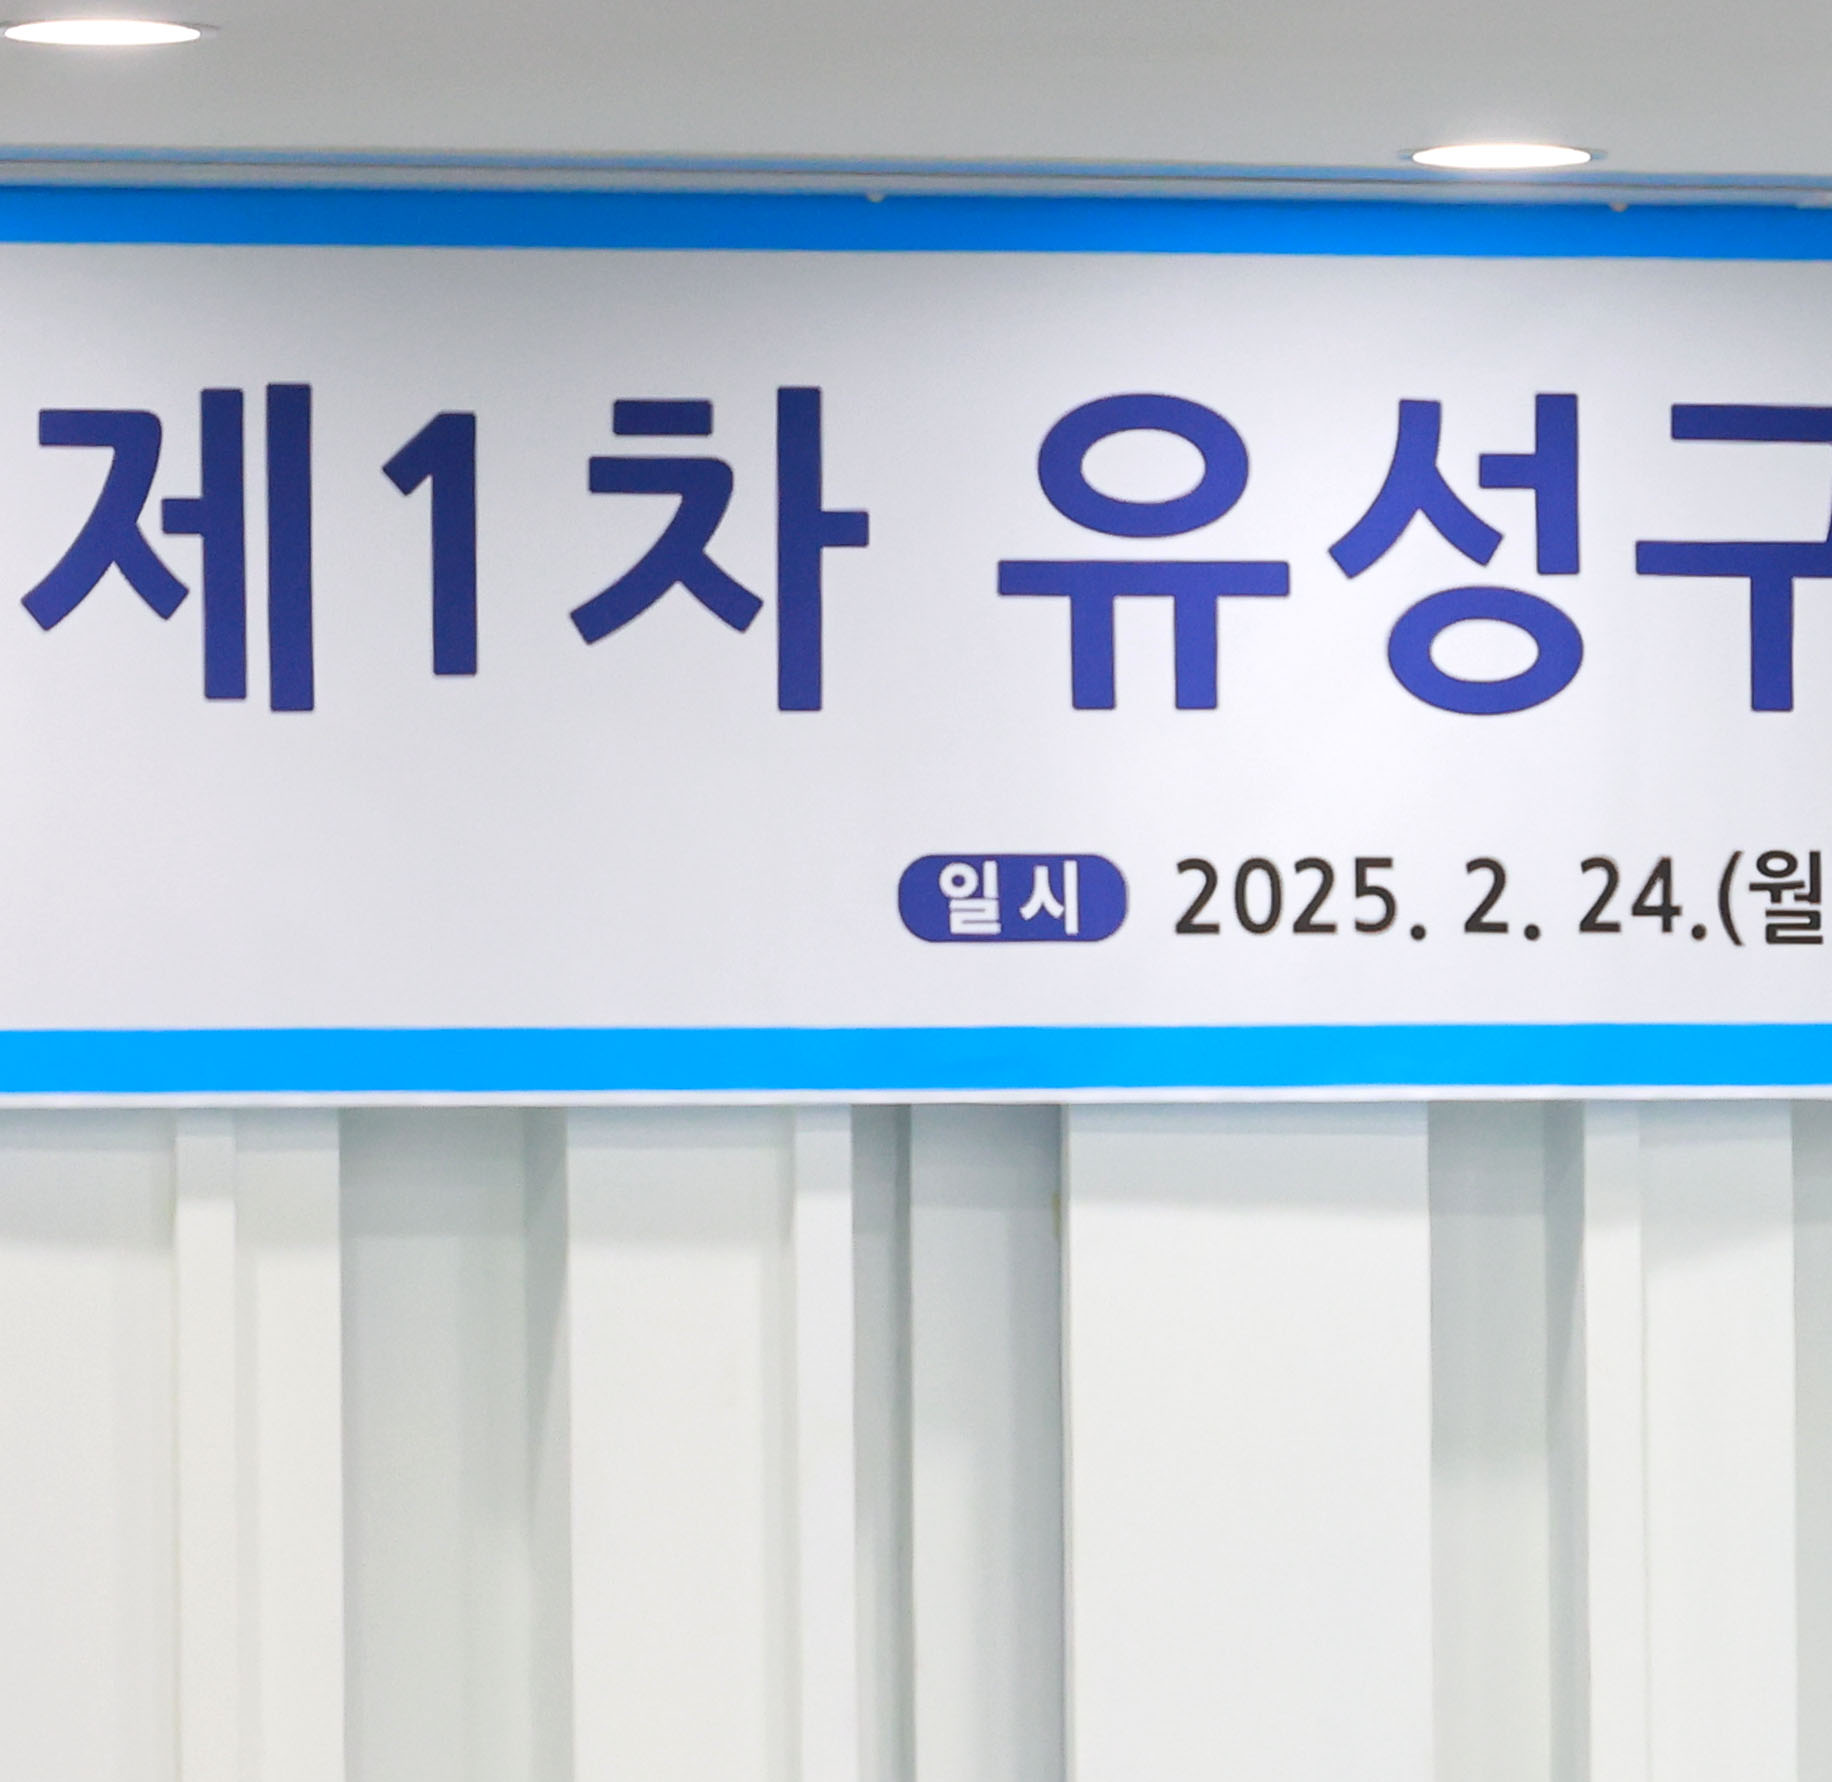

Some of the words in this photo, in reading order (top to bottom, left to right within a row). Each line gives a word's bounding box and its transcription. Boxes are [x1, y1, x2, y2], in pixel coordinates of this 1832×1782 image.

[20, 382, 870, 713] 제1차
[937, 859, 1082, 936] 일시
[1175, 856, 1427, 942] 2025.
[1463, 857, 1541, 942] 2.
